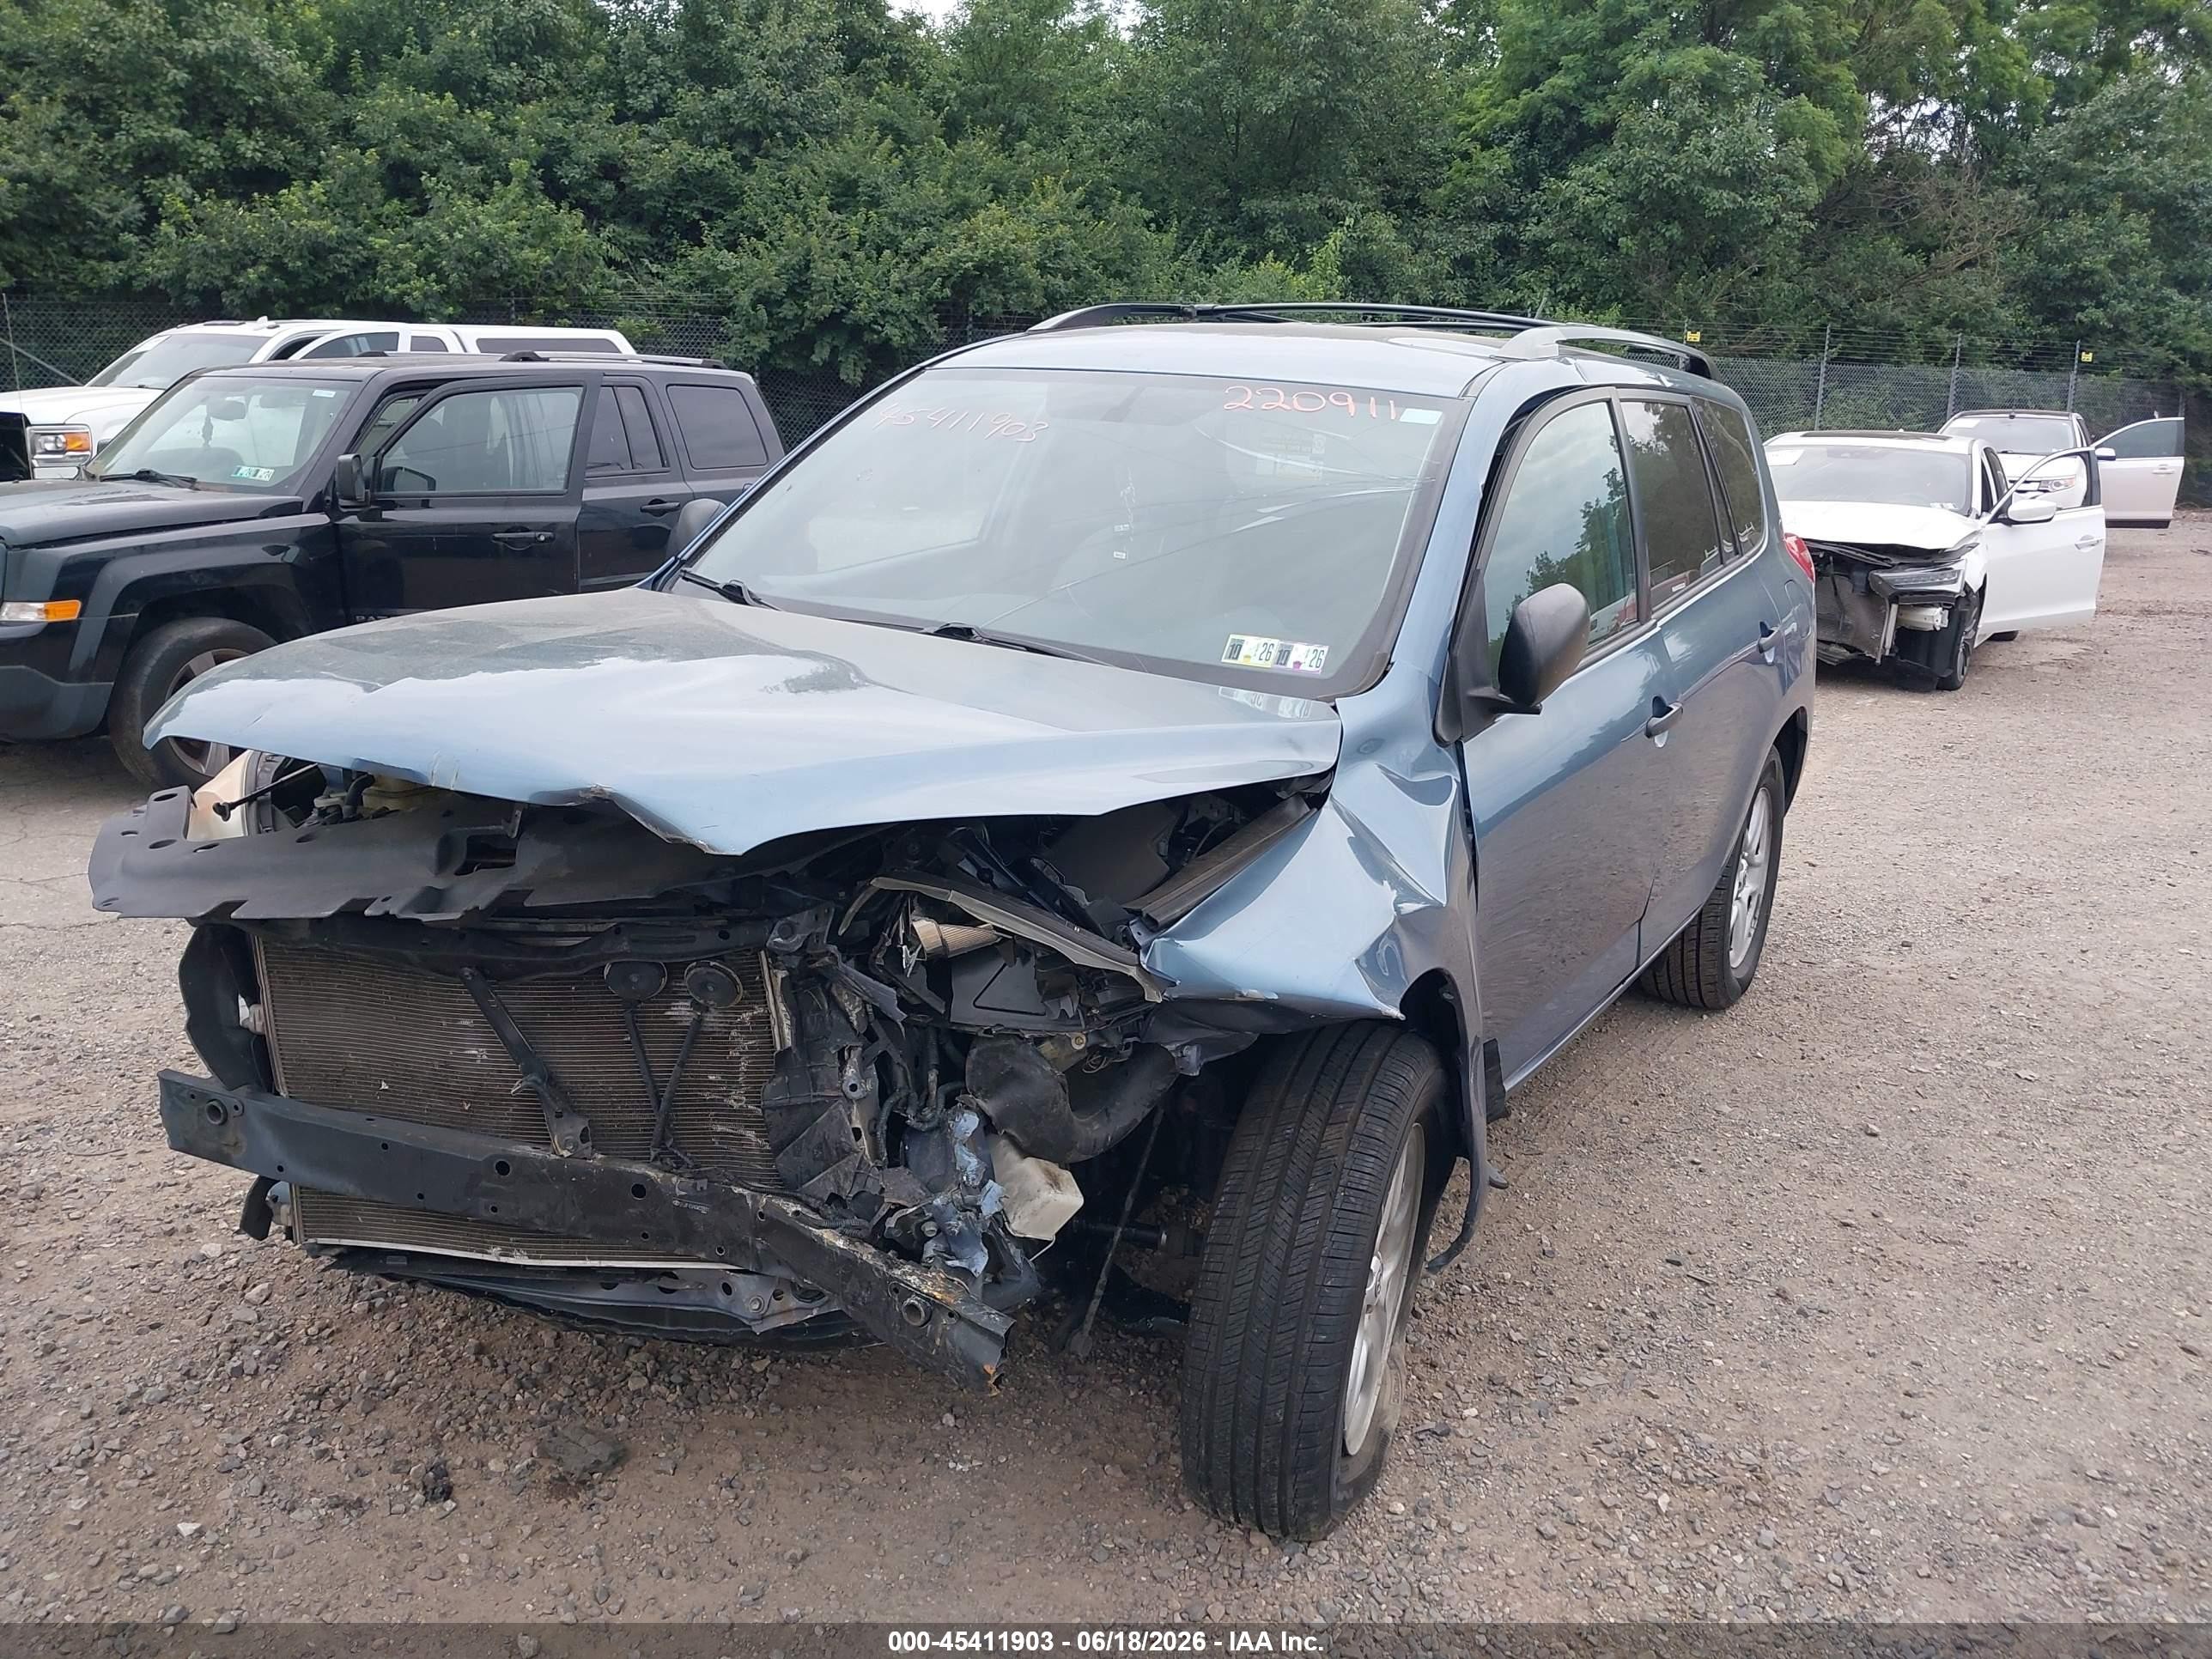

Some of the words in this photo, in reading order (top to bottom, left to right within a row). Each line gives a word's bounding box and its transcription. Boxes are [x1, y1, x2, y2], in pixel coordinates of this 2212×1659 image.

[1223, 385, 1397, 420] 220911
[872, 402, 1049, 442] 45411903
[1227, 643, 1243, 660] 10
[1258, 642, 1275, 662] 26
[1308, 648, 1325, 669] 26
